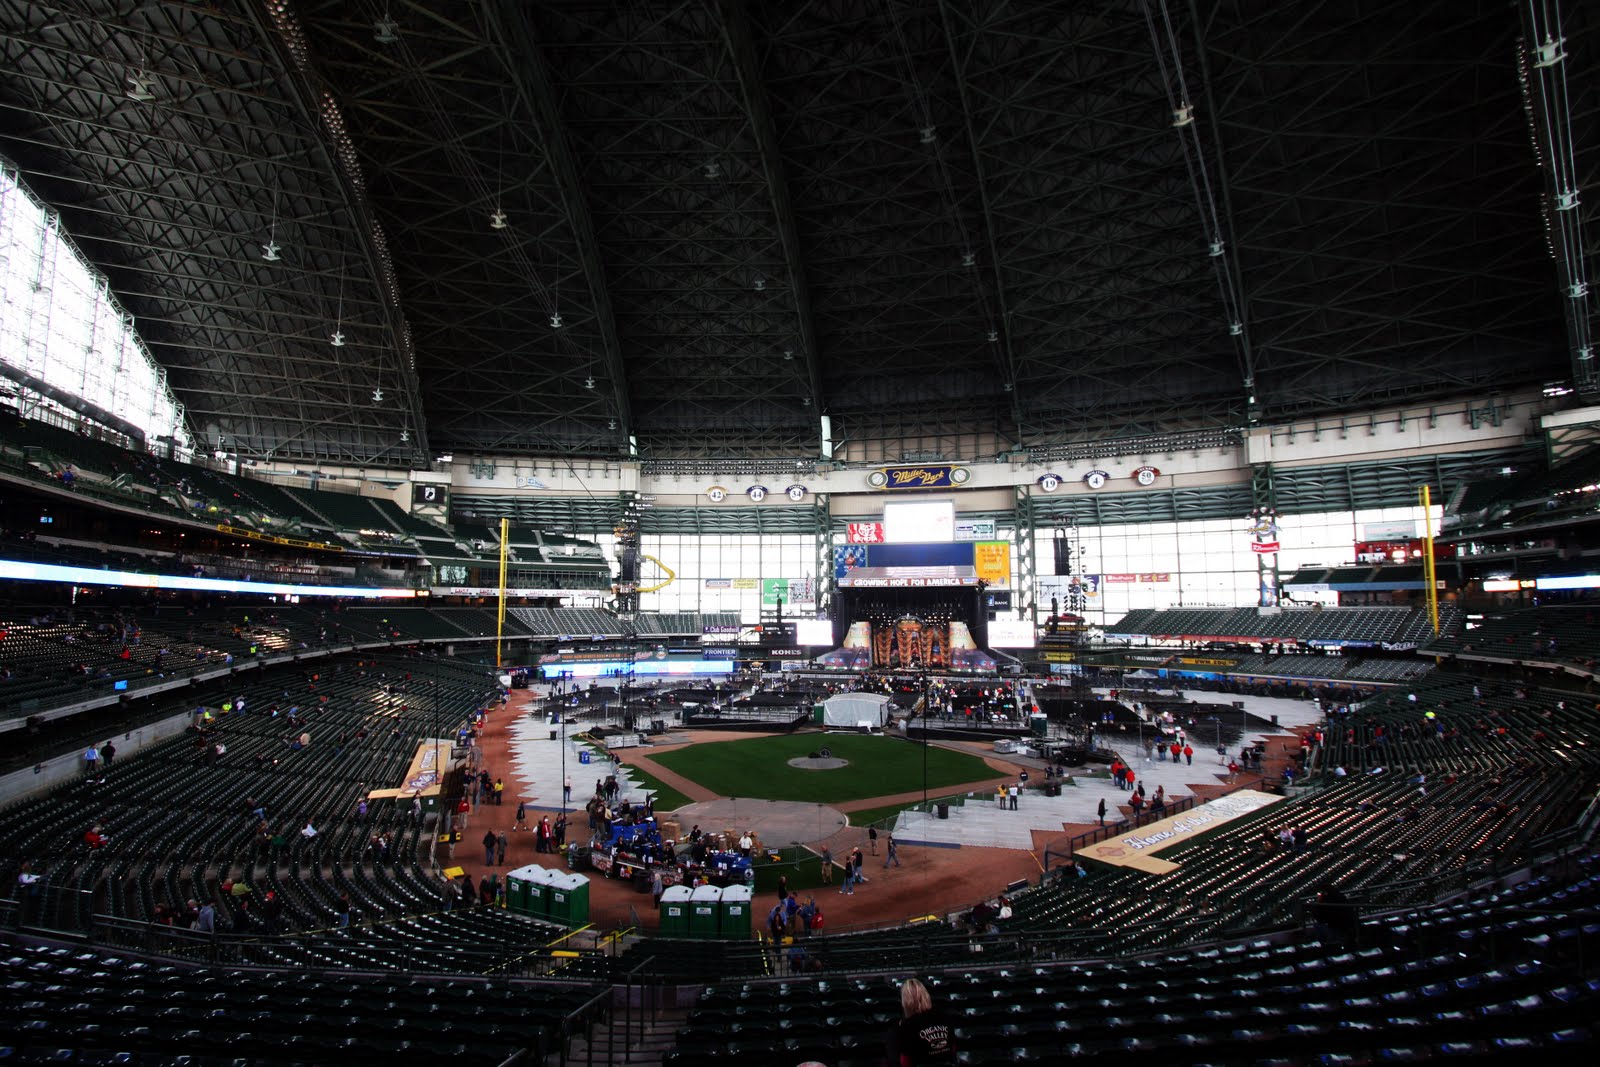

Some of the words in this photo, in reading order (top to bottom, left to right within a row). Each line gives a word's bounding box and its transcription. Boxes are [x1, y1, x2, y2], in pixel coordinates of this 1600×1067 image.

[893, 470, 924, 484] Miller
[920, 471, 945, 485] Park
[1141, 473, 1152, 481] 50
[1045, 480, 1056, 488] 19
[1093, 478, 1099, 486] 4
[712, 491, 722, 499] 42
[753, 491, 763, 499] 44
[792, 490, 802, 498] 34
[854, 579, 889, 587] GROWING
[911, 578, 925, 586] FOR
[1123, 830, 1175, 849] Home
[1172, 821, 1192, 832] of
[1187, 814, 1212, 826] the
[920, 1025, 949, 1039] ORGANIC
[925, 1032, 948, 1042] VALLEY
